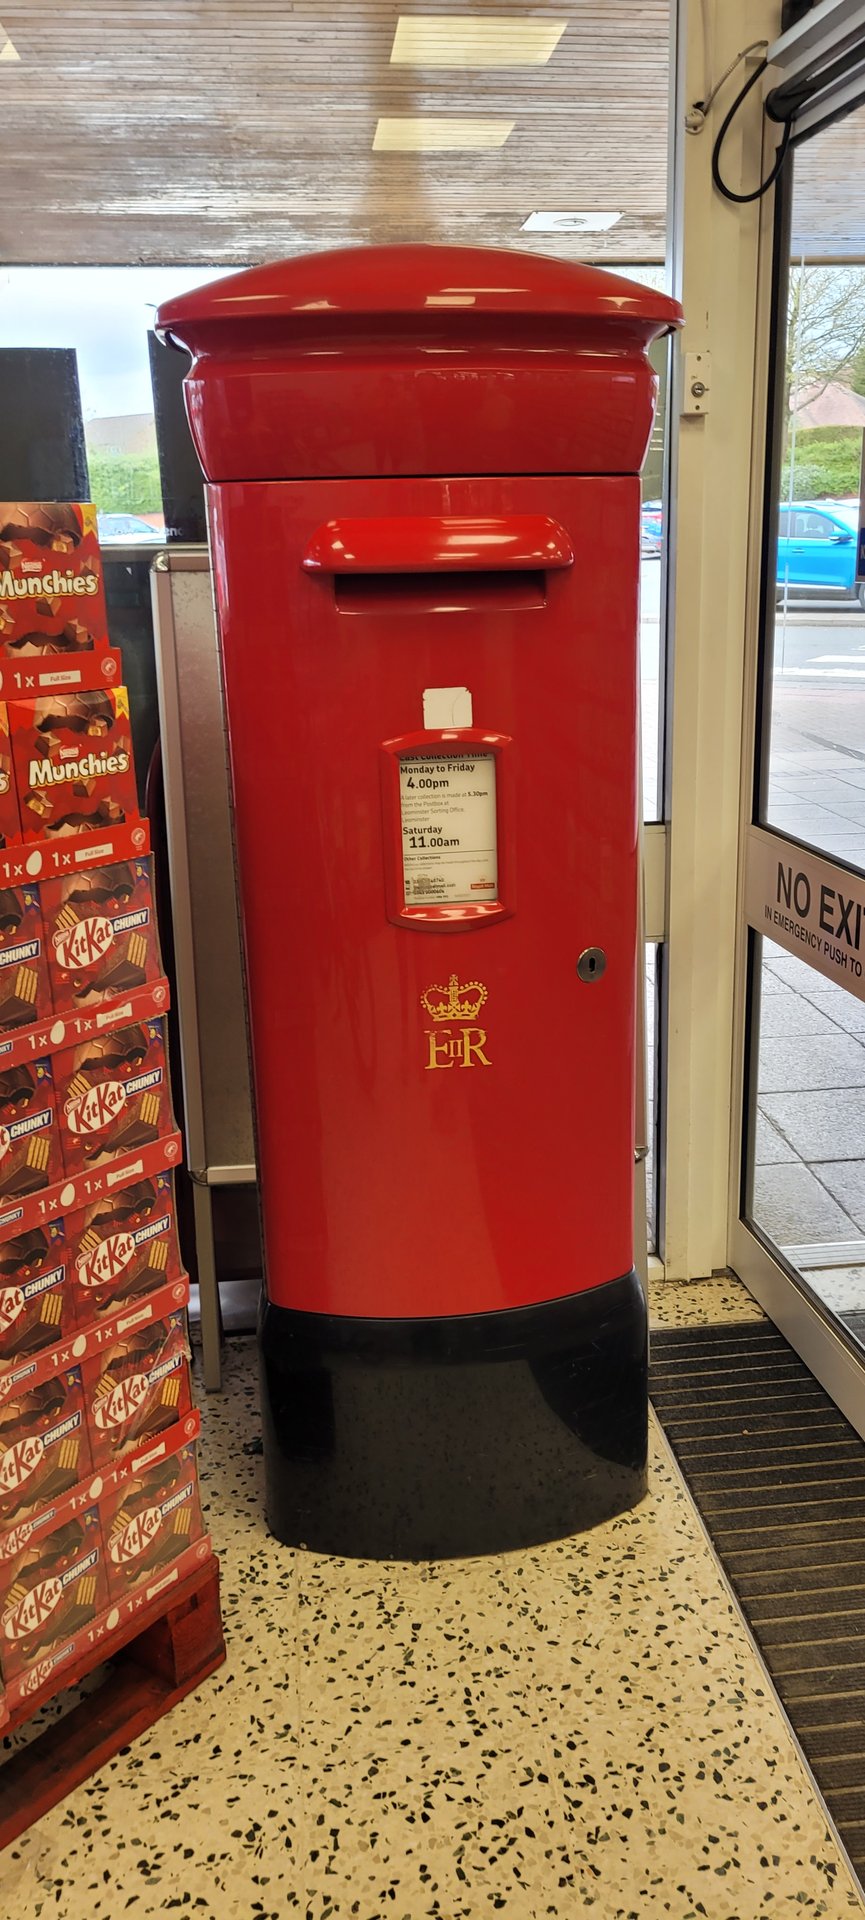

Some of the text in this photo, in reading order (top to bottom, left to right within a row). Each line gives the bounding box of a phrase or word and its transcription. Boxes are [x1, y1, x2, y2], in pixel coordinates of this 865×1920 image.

[0, 570, 97, 597] Munchies
[29, 752, 128, 786] Munchies
[401, 763, 475, 775] Monday to Friday
[407, 777, 449, 789] 4.00pm
[403, 826, 442, 835] Saturday
[409, 836, 460, 848] 11.00am
[777, 862, 865, 951] NO EXI
[114, 911, 148, 932] CHUNKY
[765, 905, 862, 977] IN EMERGENCY PUSH TO
[126, 1071, 161, 1094] CHUNKY
[11, 1113, 50, 1137] CHUNKY
[135, 1218, 169, 1244] CHUNKY
[25, 1269, 63, 1297] CHUNKY
[149, 1357, 180, 1383] CHUNKY
[44, 1415, 80, 1446] CHUNKY
[162, 1485, 192, 1514] CHUNKY
[62, 1551, 97, 1586] CHUNKY
